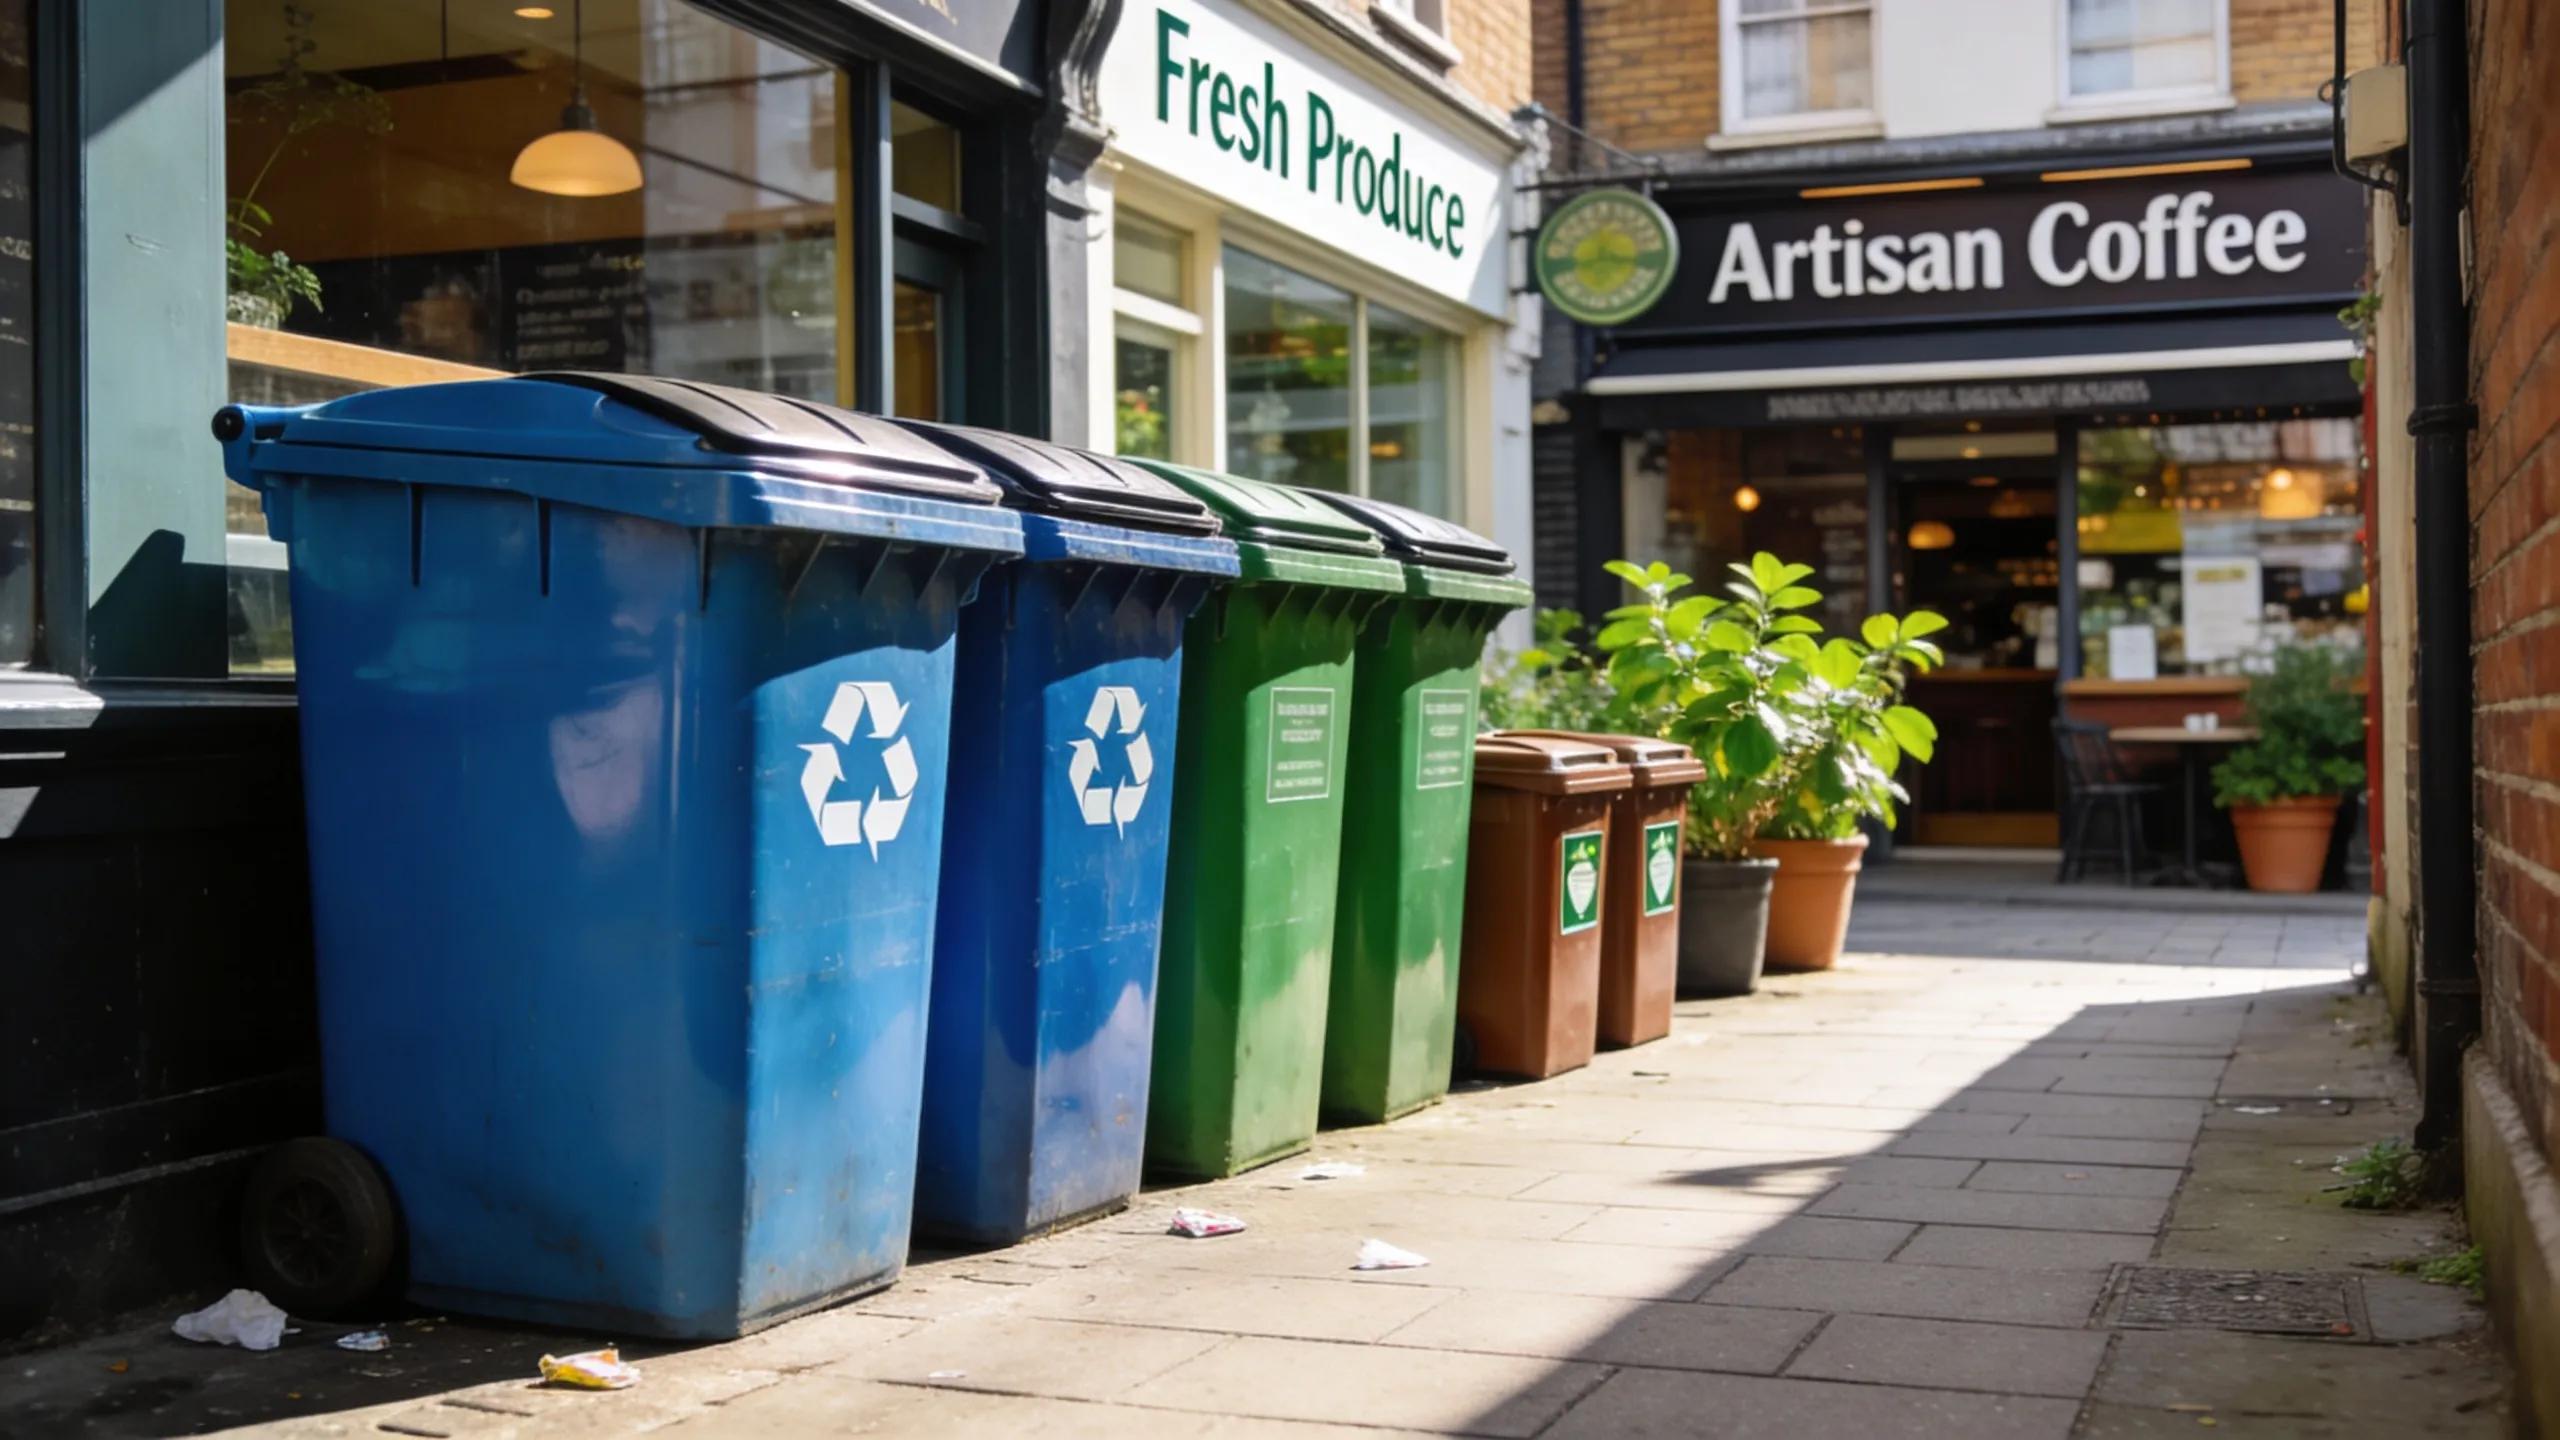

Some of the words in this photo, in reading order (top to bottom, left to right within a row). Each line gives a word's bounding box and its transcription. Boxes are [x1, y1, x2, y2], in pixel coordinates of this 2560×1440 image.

[1156, 7, 1289, 180] Fresh
[1307, 90, 1465, 259] Produce
[1708, 218, 2004, 303] Artisan
[2028, 191, 2307, 287] Coffee
